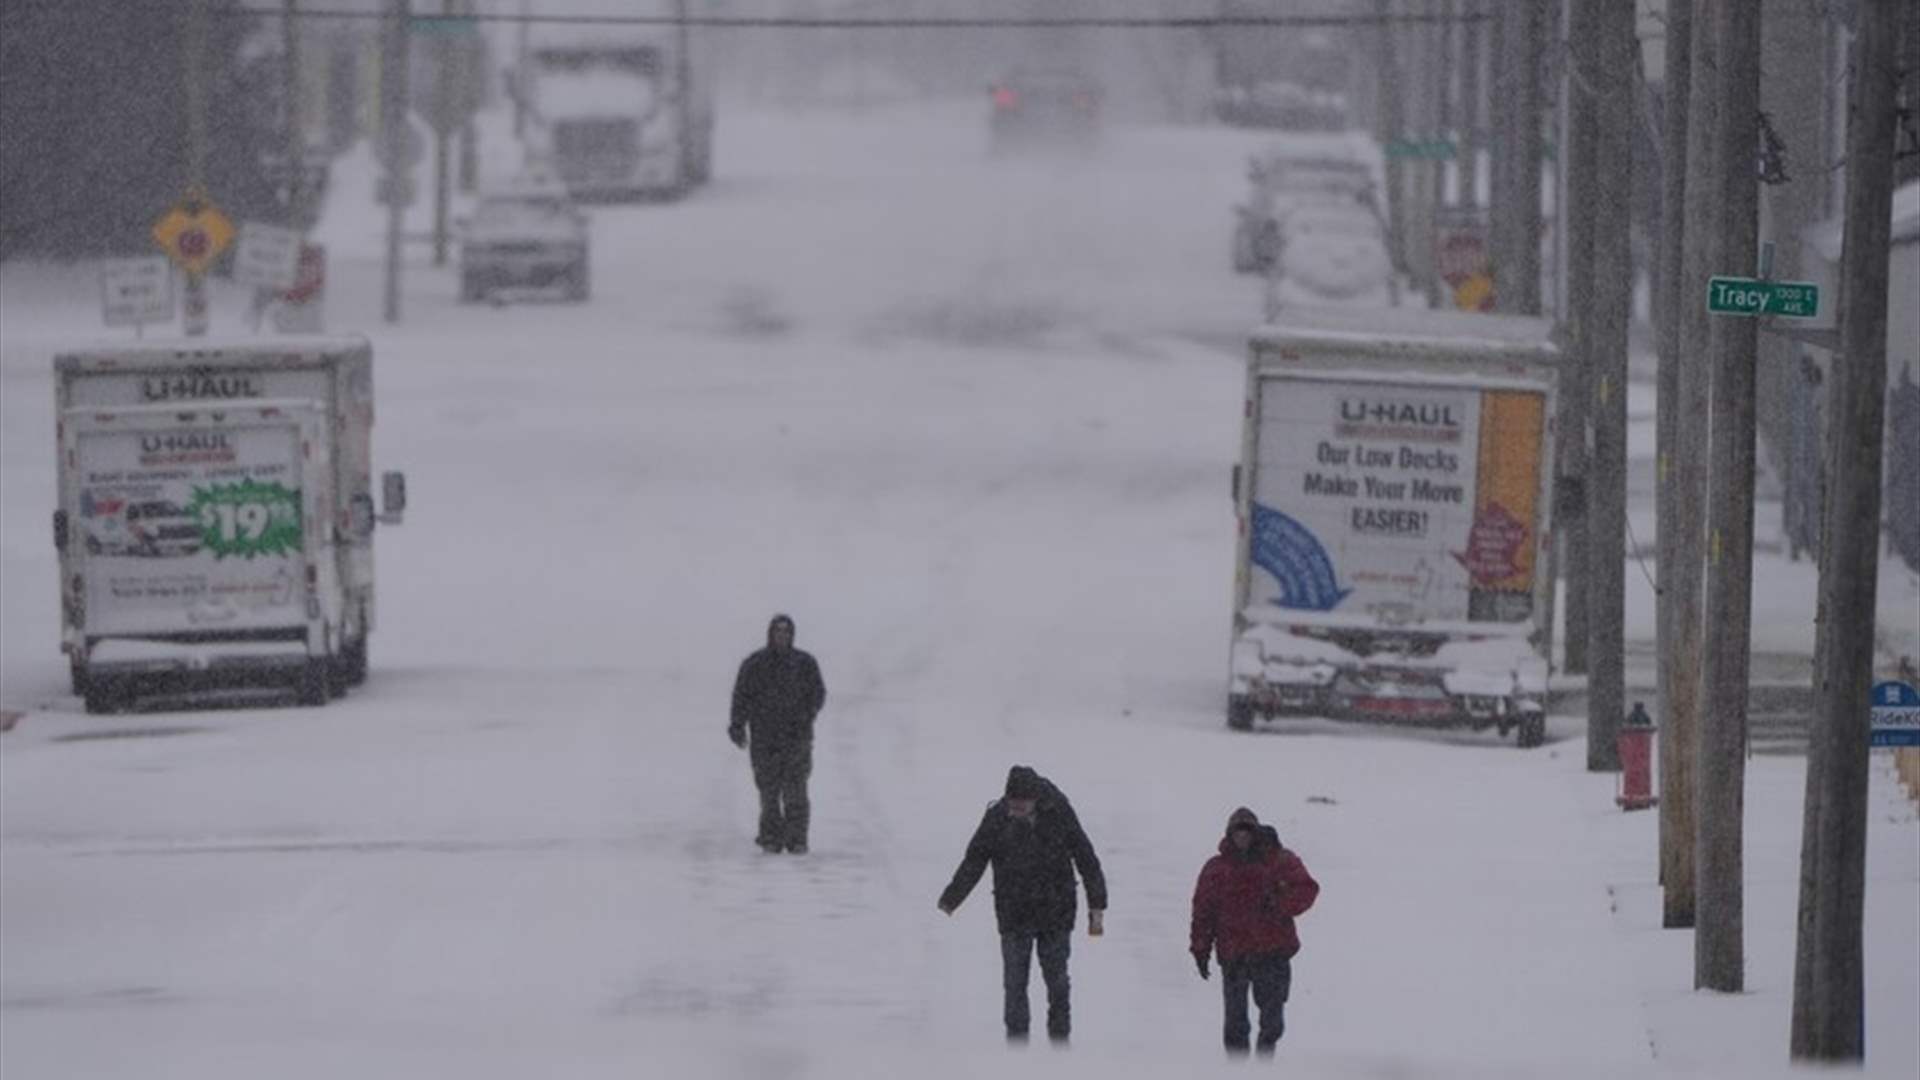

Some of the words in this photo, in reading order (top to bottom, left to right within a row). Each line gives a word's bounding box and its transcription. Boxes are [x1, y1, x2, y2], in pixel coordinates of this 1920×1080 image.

[1715, 283, 1770, 312] Tracy
[144, 378, 259, 401] U-HAUL
[1340, 400, 1459, 426] U-HAUL
[141, 434, 232, 452] U-HAUL
[1317, 441, 1349, 466] Our
[1355, 443, 1392, 467] Low
[1399, 446, 1459, 473] Decks
[1304, 473, 1358, 497] Make
[1363, 477, 1407, 501] Your
[1412, 480, 1463, 503] Move
[1352, 507, 1428, 533] EASIER!
